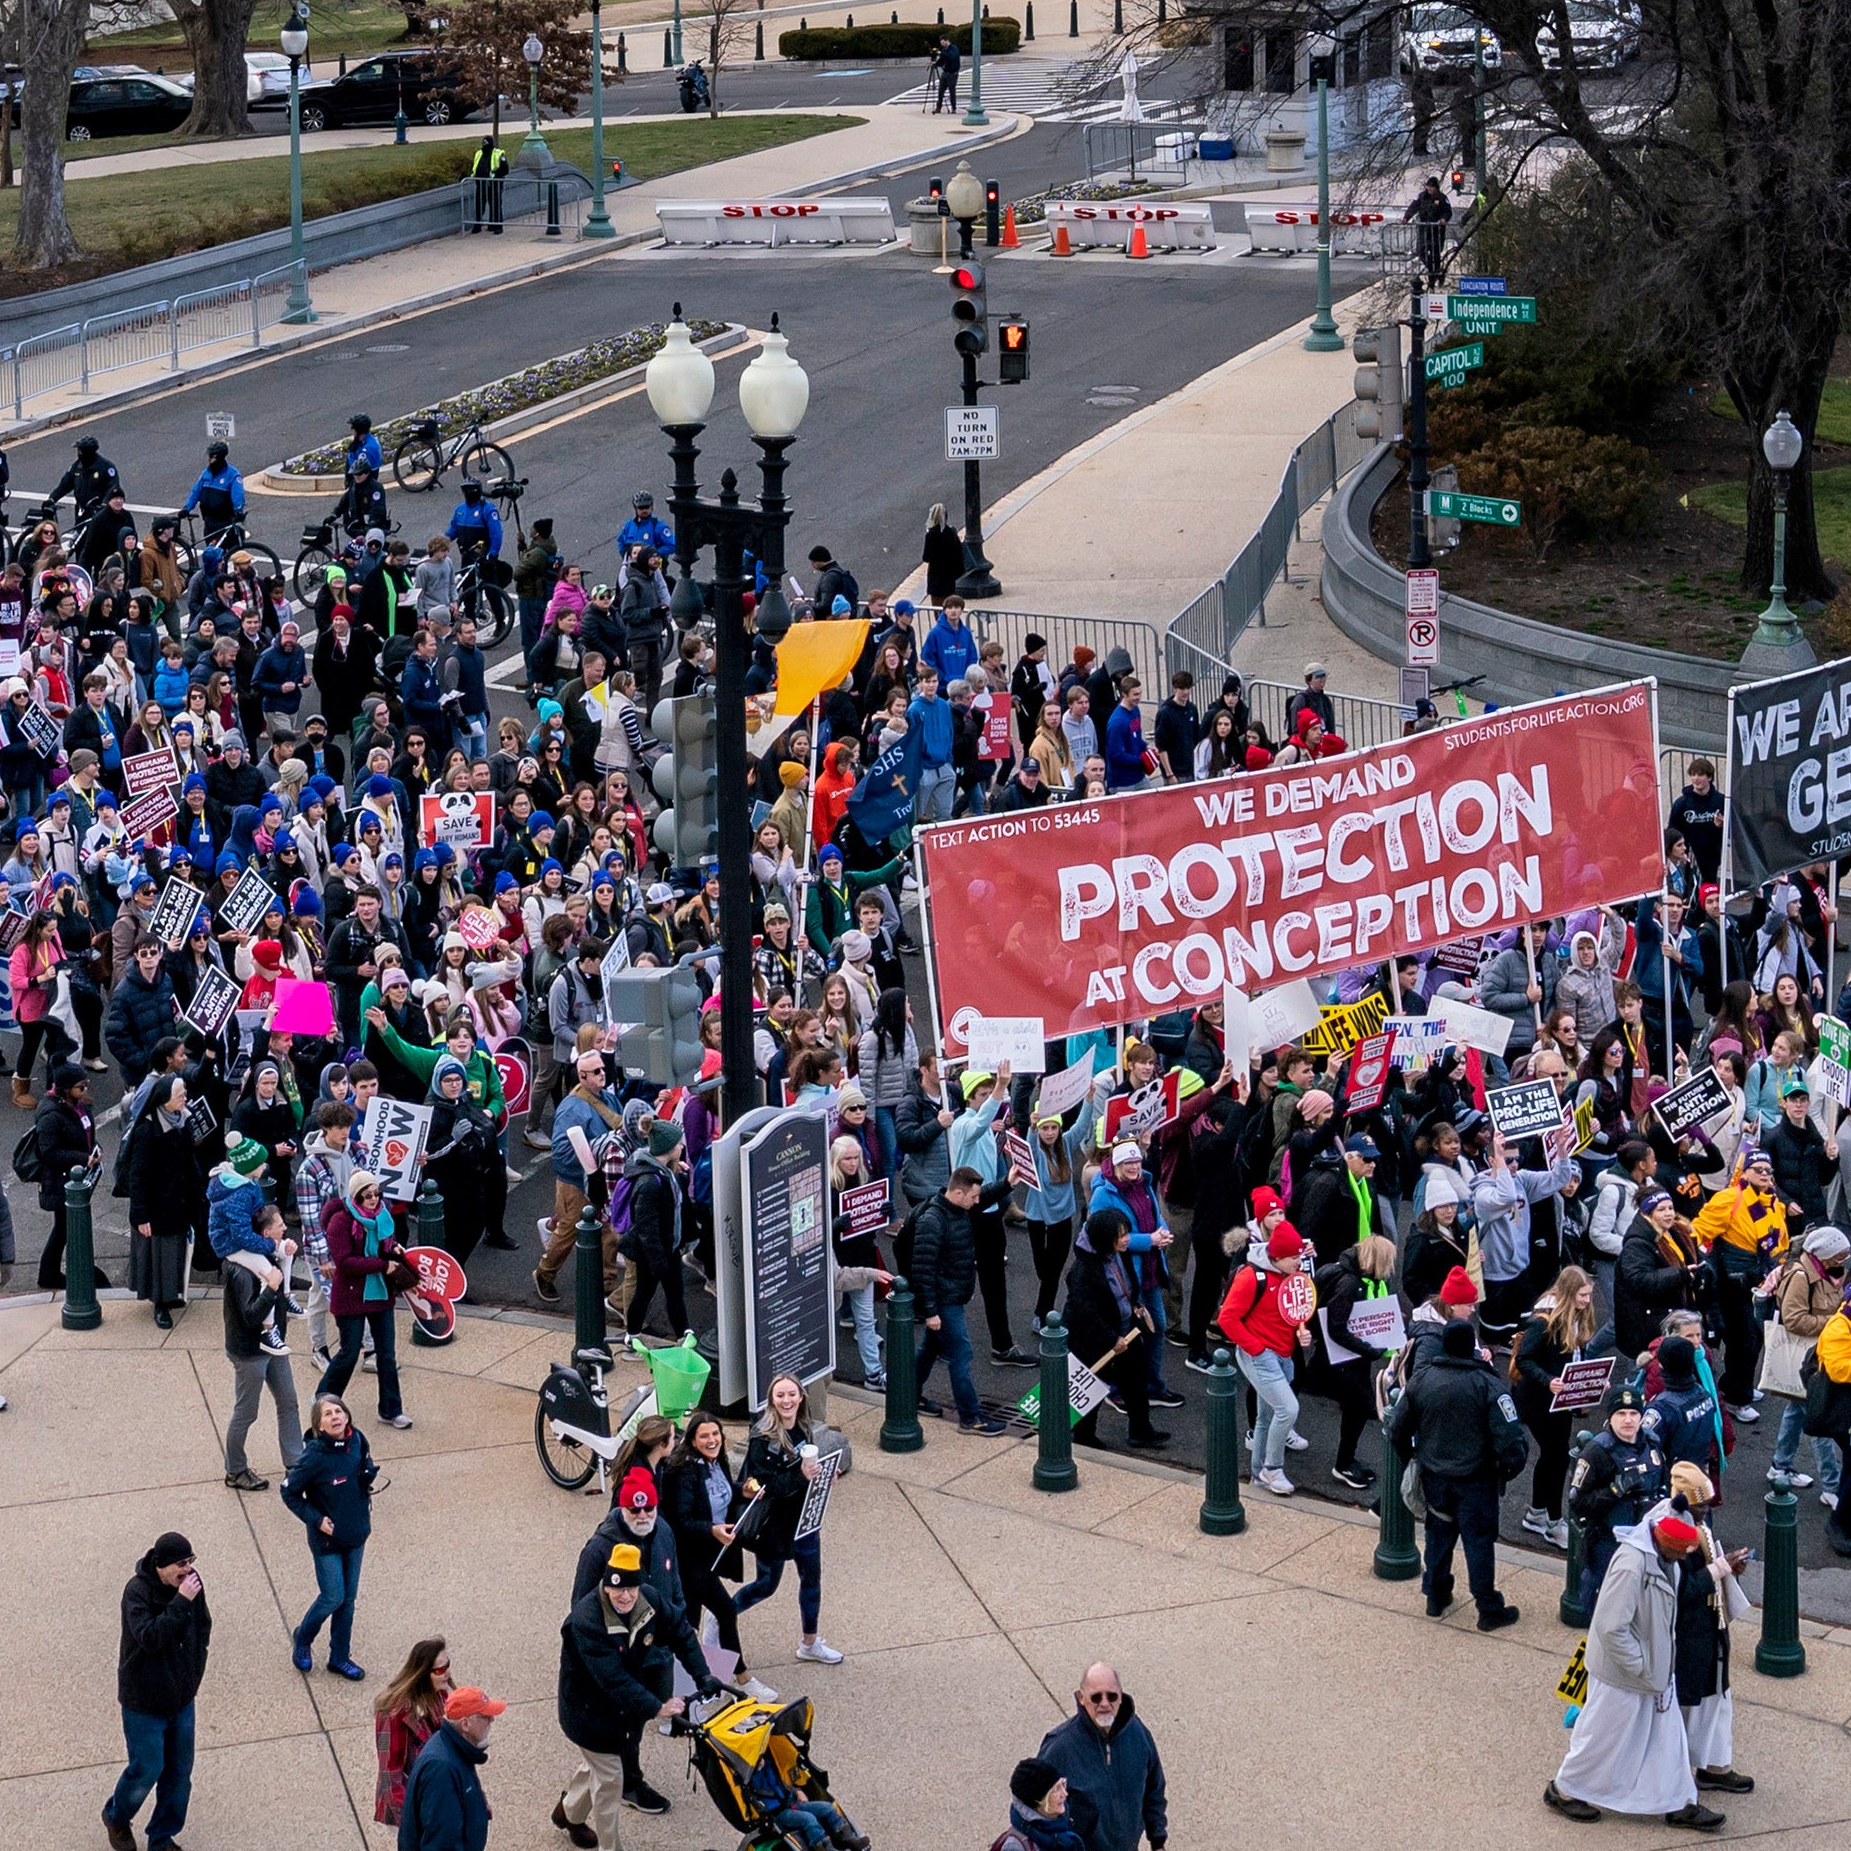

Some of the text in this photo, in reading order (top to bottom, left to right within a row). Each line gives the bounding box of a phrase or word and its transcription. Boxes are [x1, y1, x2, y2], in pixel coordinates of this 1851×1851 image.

[723, 205, 819, 217] STOP
[1073, 208, 1179, 221] STOP
[1275, 211, 1384, 226] STOP
[1461, 281, 1504, 291] EVACUATION ROUTE
[1453, 299, 1518, 320] Independence
[1466, 322, 1496, 334] UNIT
[1426, 350, 1471, 376] CAPITOL
[1443, 372, 1465, 386] 100
[962, 410, 979, 420] NO
[957, 424, 987, 433] TURN
[951, 434, 995, 444] ON RED
[950, 446, 993, 457] 7AM-7PM
[1462, 502, 1492, 514] 2 Blocks
[1444, 692, 1645, 750] STUDENTSFORLIFEACTION.ORG
[1737, 698, 1801, 765] WE
[136, 755, 169, 770] DEMAND
[873, 746, 905, 776] SHS
[128, 764, 175, 780] PROTECTION
[1194, 754, 1417, 828] WE DEMAND
[442, 817, 473, 830] SAVE
[930, 807, 1100, 849] TEXT ACTION TO 53445
[1058, 763, 1552, 941] PROTECTION
[1085, 856, 1543, 1006] AT CONCEPTION
[1325, 997, 1388, 1045] LIFE WINS
[1503, 1094, 1523, 1106] AM
[1526, 1087, 1550, 1100] THE
[1129, 1103, 1159, 1126] SAVE
[1494, 1097, 1556, 1120] PRO-LIFE
[1669, 1092, 1727, 1129] ABORTION
[1498, 1111, 1558, 1131] GENERATION
[775, 1142, 802, 1161] CANNON
[852, 1189, 882, 1206] DEMAND
[1289, 1275, 1304, 1292] LET
[1283, 1287, 1314, 1308] LIFE
[1361, 1311, 1395, 1323] PERSON
[1365, 1326, 1391, 1336] BORN
